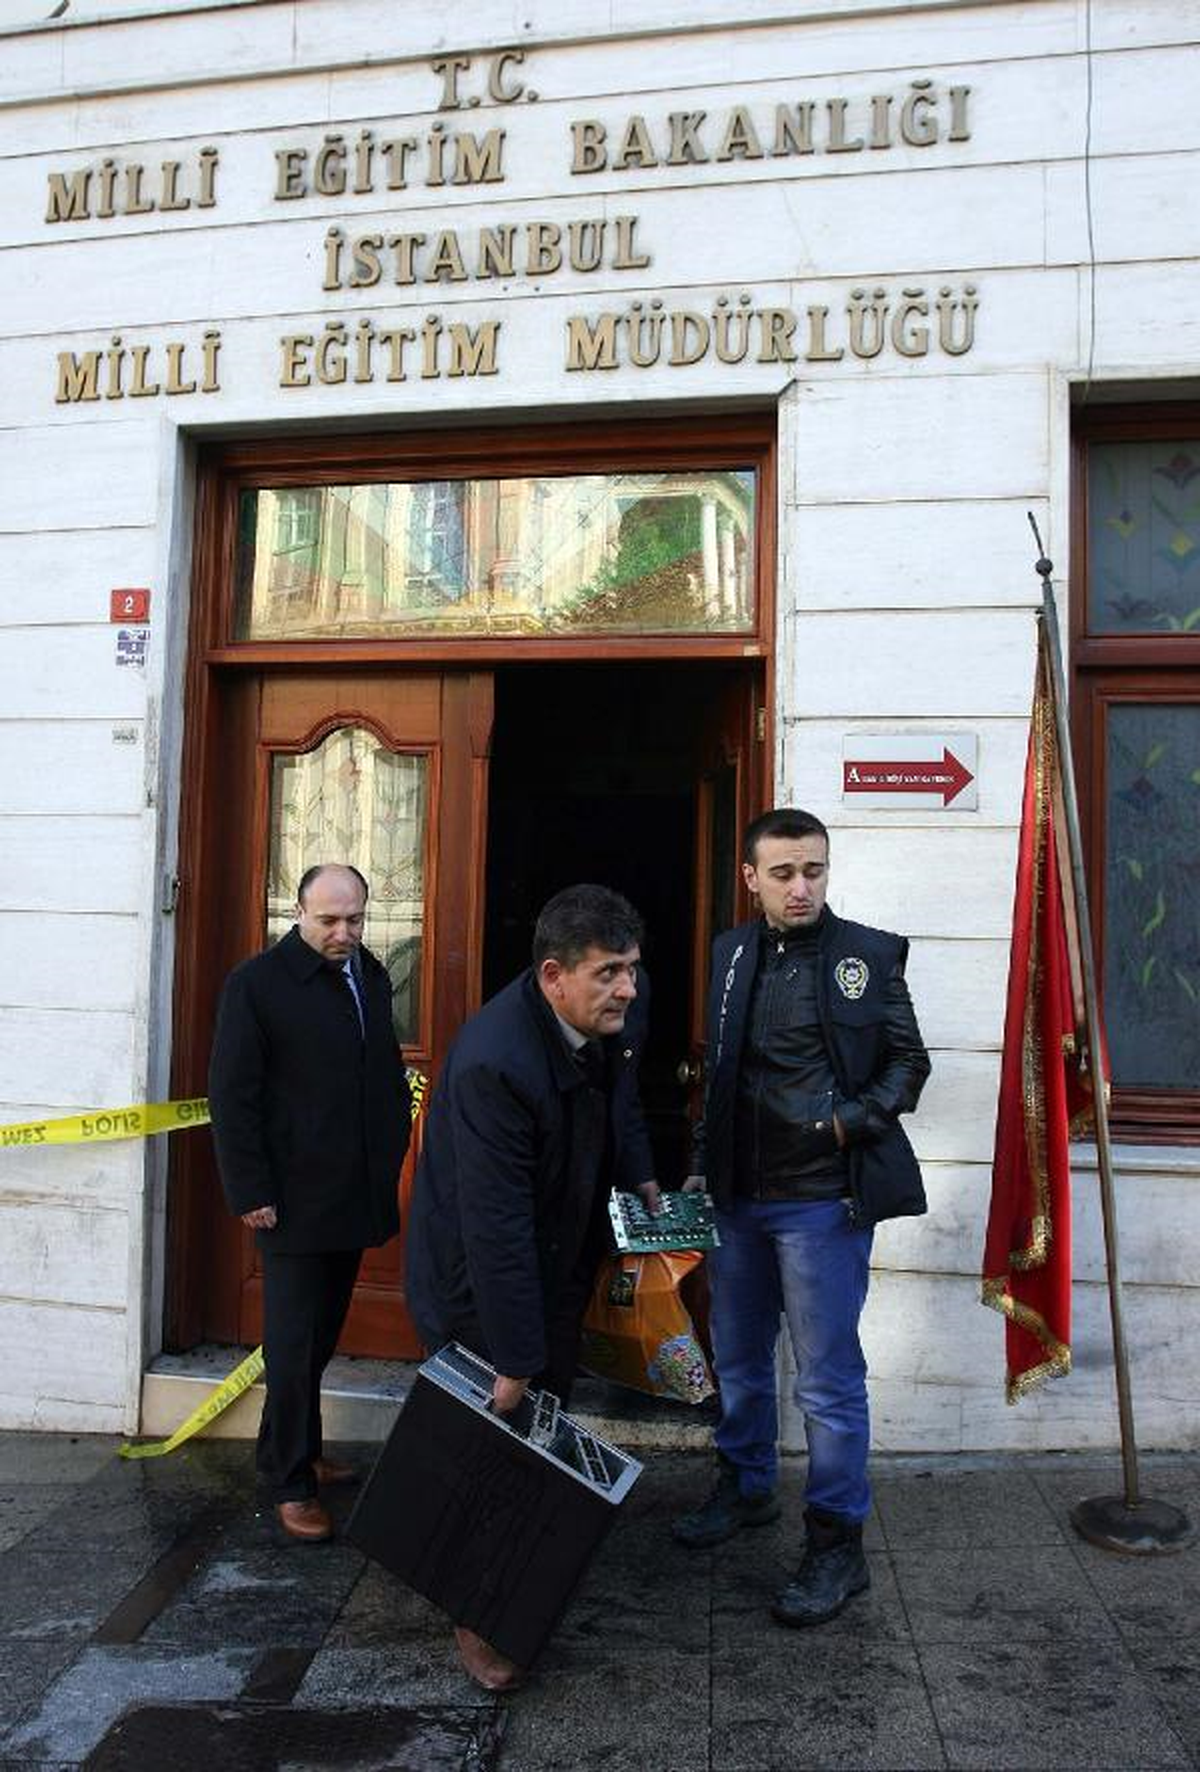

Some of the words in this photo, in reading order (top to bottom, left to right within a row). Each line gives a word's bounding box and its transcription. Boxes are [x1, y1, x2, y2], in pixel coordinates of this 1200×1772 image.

[430, 52, 539, 112] T.C.
[274, 121, 506, 201] EĞİTİM
[570, 79, 971, 176] BAKANLIĞI
[322, 215, 651, 291] İSTANBUL
[280, 314, 501, 387] EĞİTİM
[565, 284, 979, 372] MÜDÜRLÜĞÜ
[124, 595, 134, 613] 2
